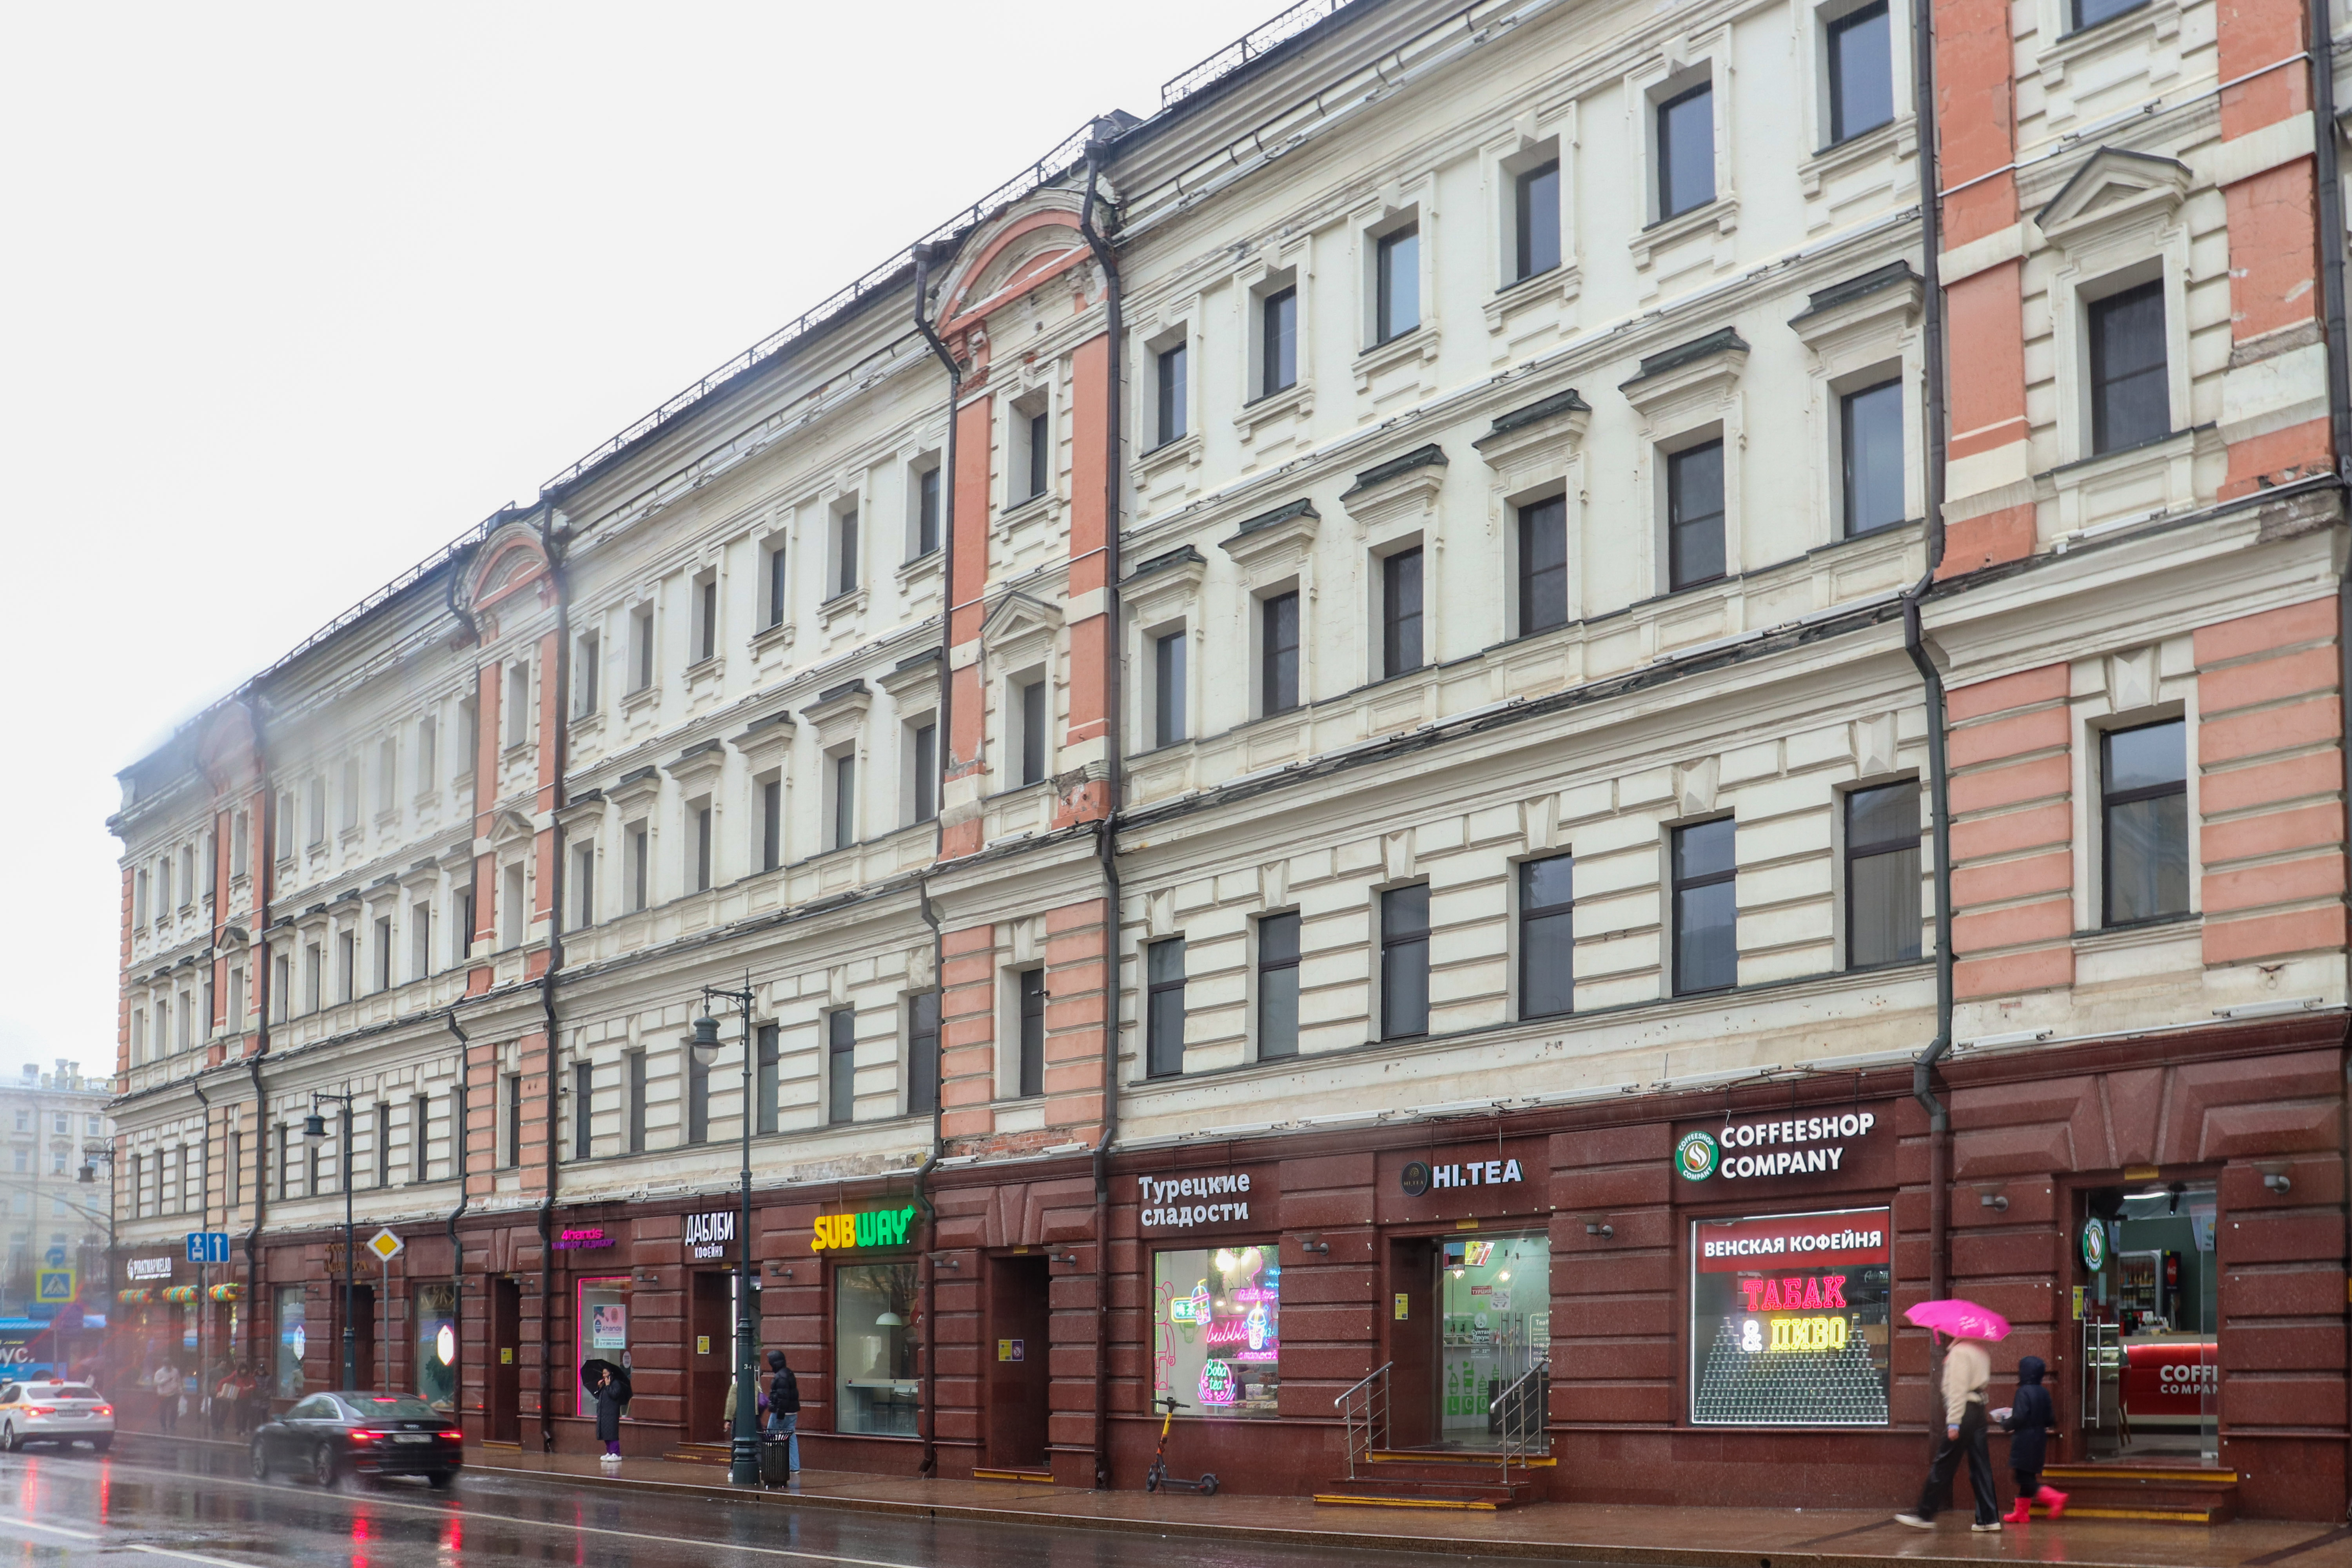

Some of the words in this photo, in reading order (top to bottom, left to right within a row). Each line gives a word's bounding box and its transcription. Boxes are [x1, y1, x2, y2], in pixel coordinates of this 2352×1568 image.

[1679, 1132, 1714, 1151] COFFEESHOP
[1720, 1112, 1875, 1149] COFFEESHOP
[1433, 1159, 1522, 1189] HI.TEA
[1683, 1165, 1713, 1180] COMPANY
[1721, 1147, 1843, 1179] COMPANY
[1138, 1173, 1250, 1205] Турецкие
[685, 1211, 733, 1246] ДАБЛБИ
[811, 1205, 916, 1253] SUBWAY
[1141, 1202, 1249, 1228] сладости
[695, 1242, 723, 1258] КОФЕЙНЯ
[1705, 1237, 1785, 1257] ВЕНСКАЯ
[1790, 1229, 1881, 1252] КОФЕЙНЯ
[1743, 1275, 1847, 1312] ТАБАК
[1206, 1321, 1249, 1343] bubble
[1742, 1319, 1762, 1351] &
[1769, 1316, 1846, 1350] ПИВО
[1205, 1359, 1227, 1377] Boba
[1209, 1377, 1223, 1390] tea
